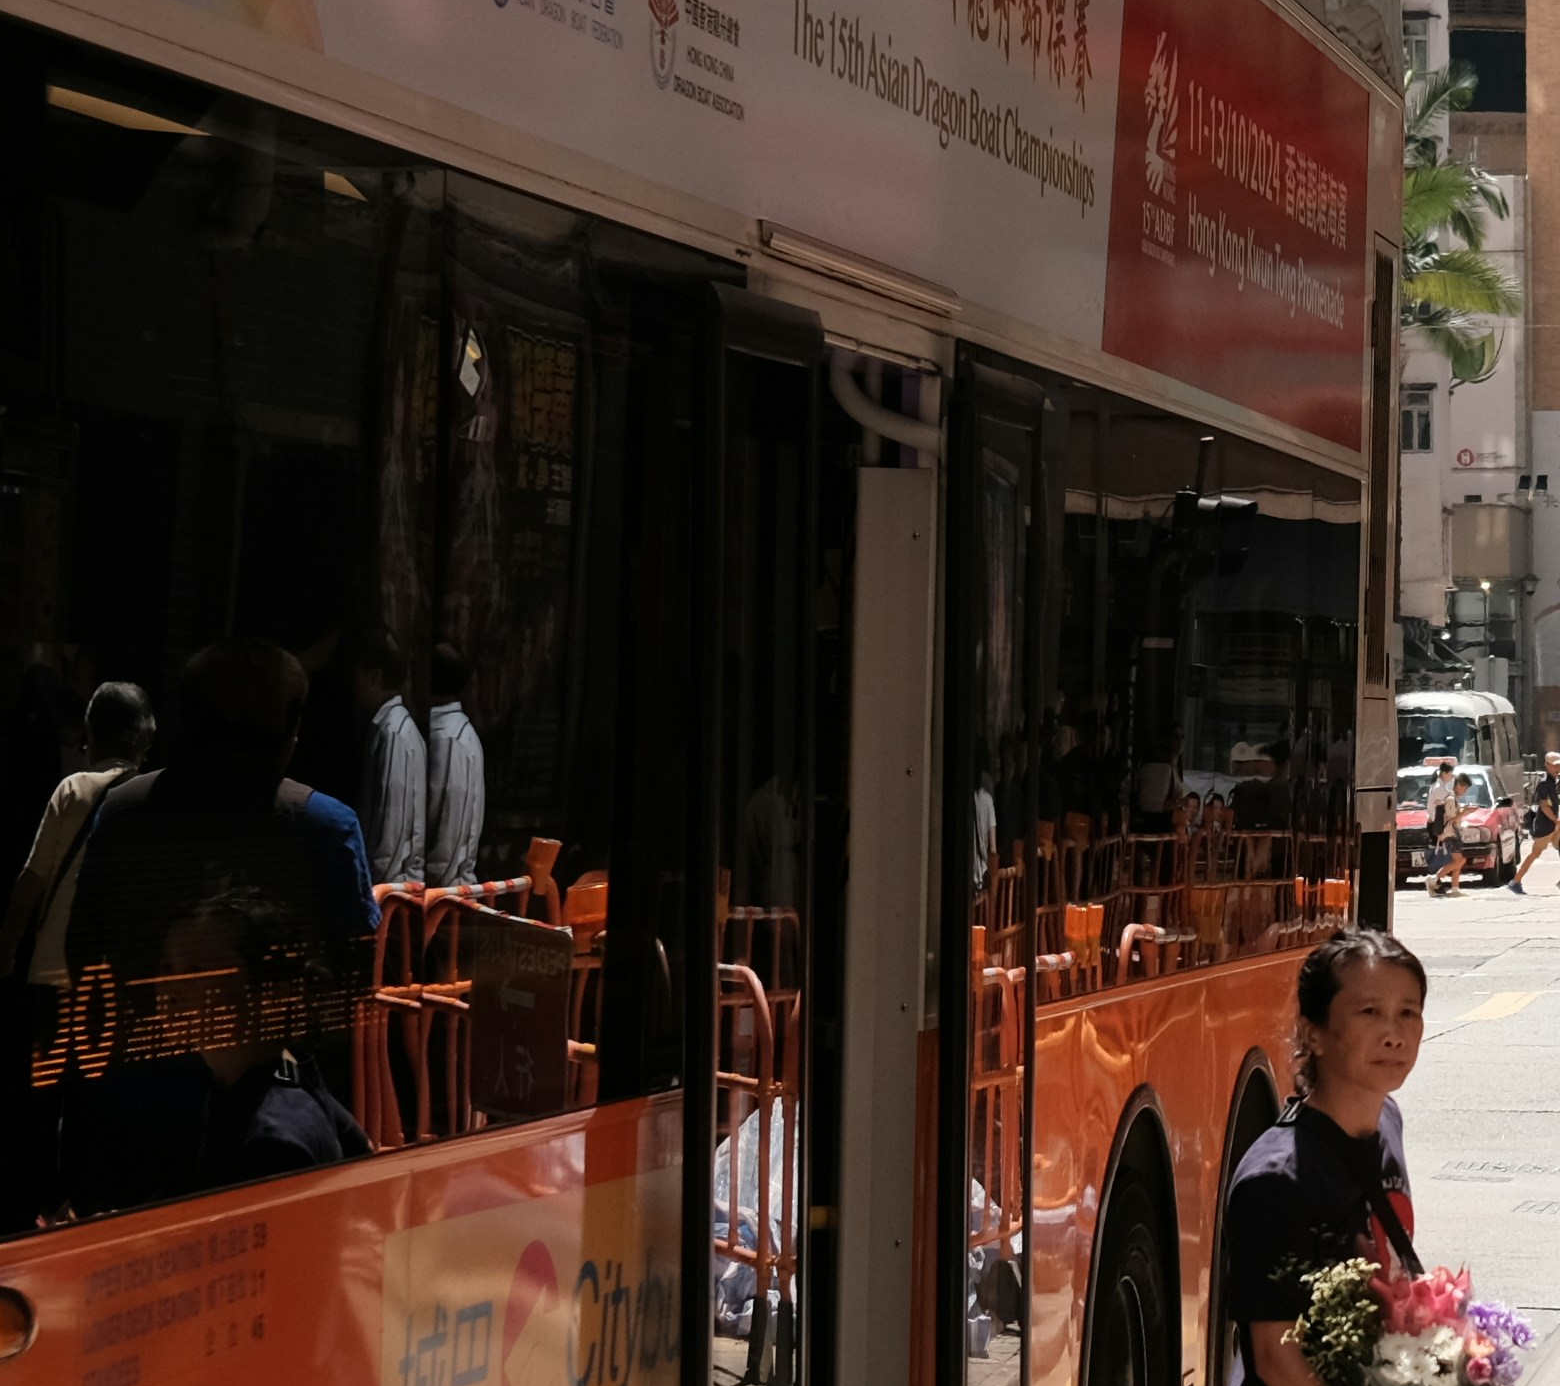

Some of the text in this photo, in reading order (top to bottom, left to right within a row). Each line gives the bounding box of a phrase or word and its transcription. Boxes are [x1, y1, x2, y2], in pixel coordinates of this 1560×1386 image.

[829, 10, 865, 90] 15th
[866, 31, 911, 113] Asian
[913, 55, 968, 151] Dragon
[969, 87, 1002, 160] Boat
[1002, 106, 1096, 220] Championships
[1188, 78, 1282, 207] 11-13/10/2024
[1187, 190, 1218, 279] Hong
[1217, 209, 1246, 293] Kong
[1246, 225, 1275, 291] Kwun
[1274, 242, 1298, 319] Tong
[1297, 255, 1346, 332] Promenade
